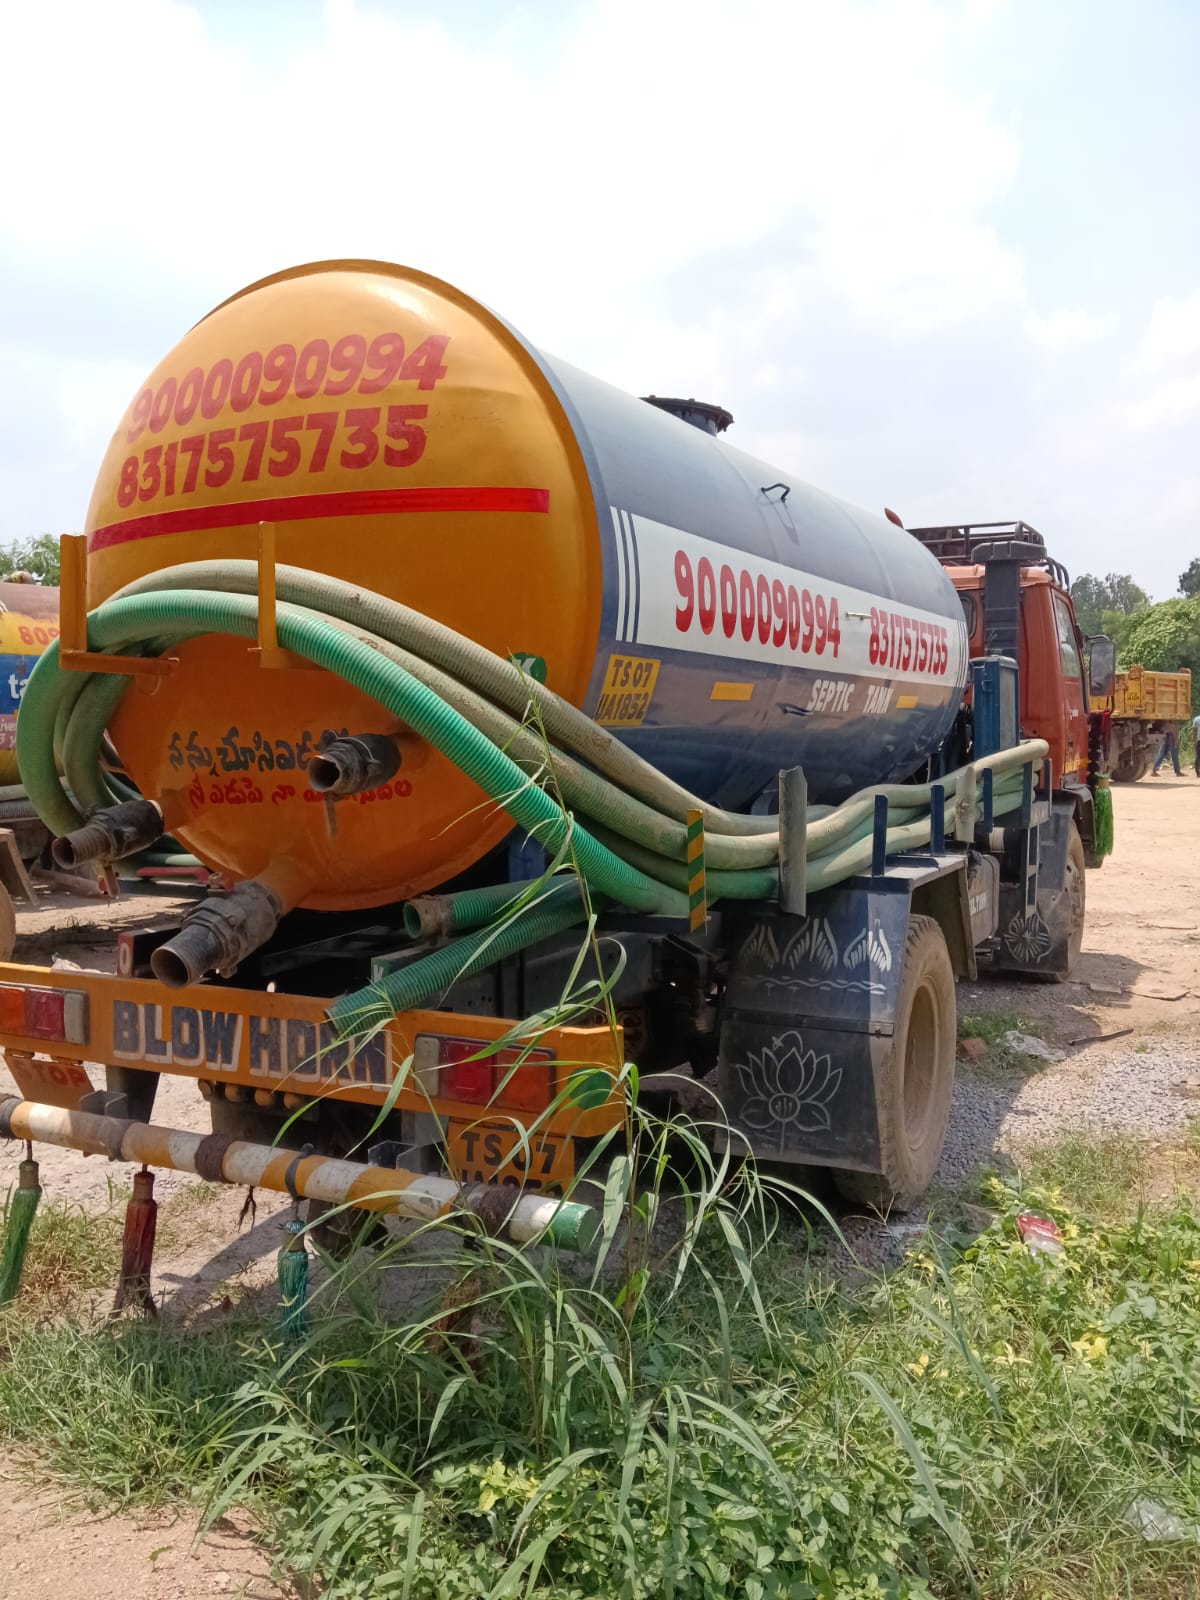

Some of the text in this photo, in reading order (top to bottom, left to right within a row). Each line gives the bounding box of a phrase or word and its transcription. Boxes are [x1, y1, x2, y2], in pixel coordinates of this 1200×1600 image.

[127, 332, 450, 443] 9000090994
[117, 404, 428, 508] 8317575735
[674, 550, 840, 658] 9000090994
[869, 606, 948, 675] 8317575735
[806, 679, 855, 712] SEPTIC
[113, 1000, 392, 1092] BLOW HORN
[461, 1131, 557, 1174] TS 07
